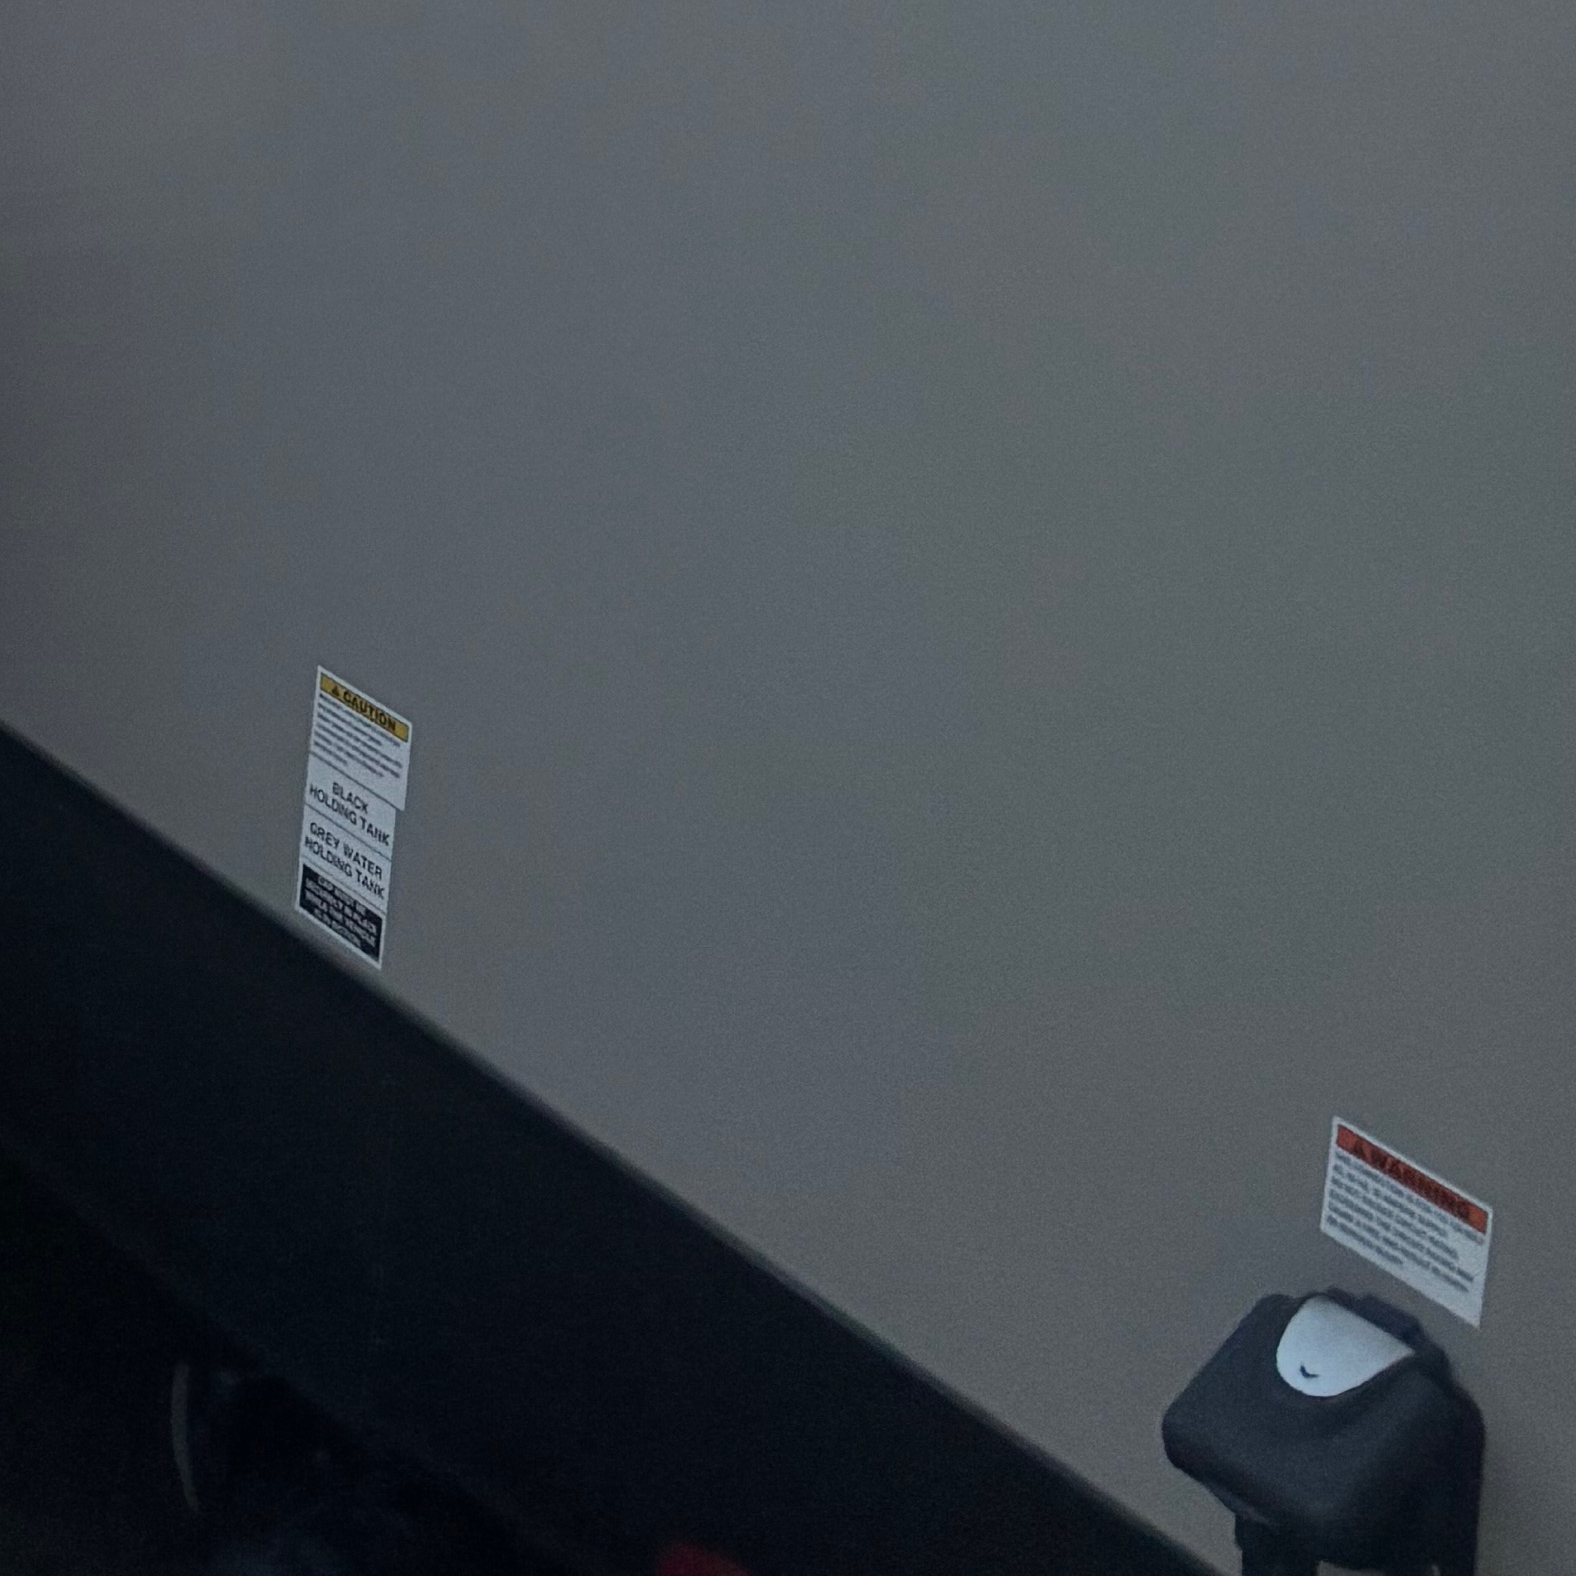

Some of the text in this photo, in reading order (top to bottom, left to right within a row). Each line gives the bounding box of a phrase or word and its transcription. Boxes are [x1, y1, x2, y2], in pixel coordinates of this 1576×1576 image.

[343, 690, 396, 732] CAUTION
[309, 784, 390, 846] HOLDING TANK
[332, 782, 368, 814] BLACK
[305, 836, 384, 899] HOLDING TANK
[310, 822, 382, 880] GREY WATER
